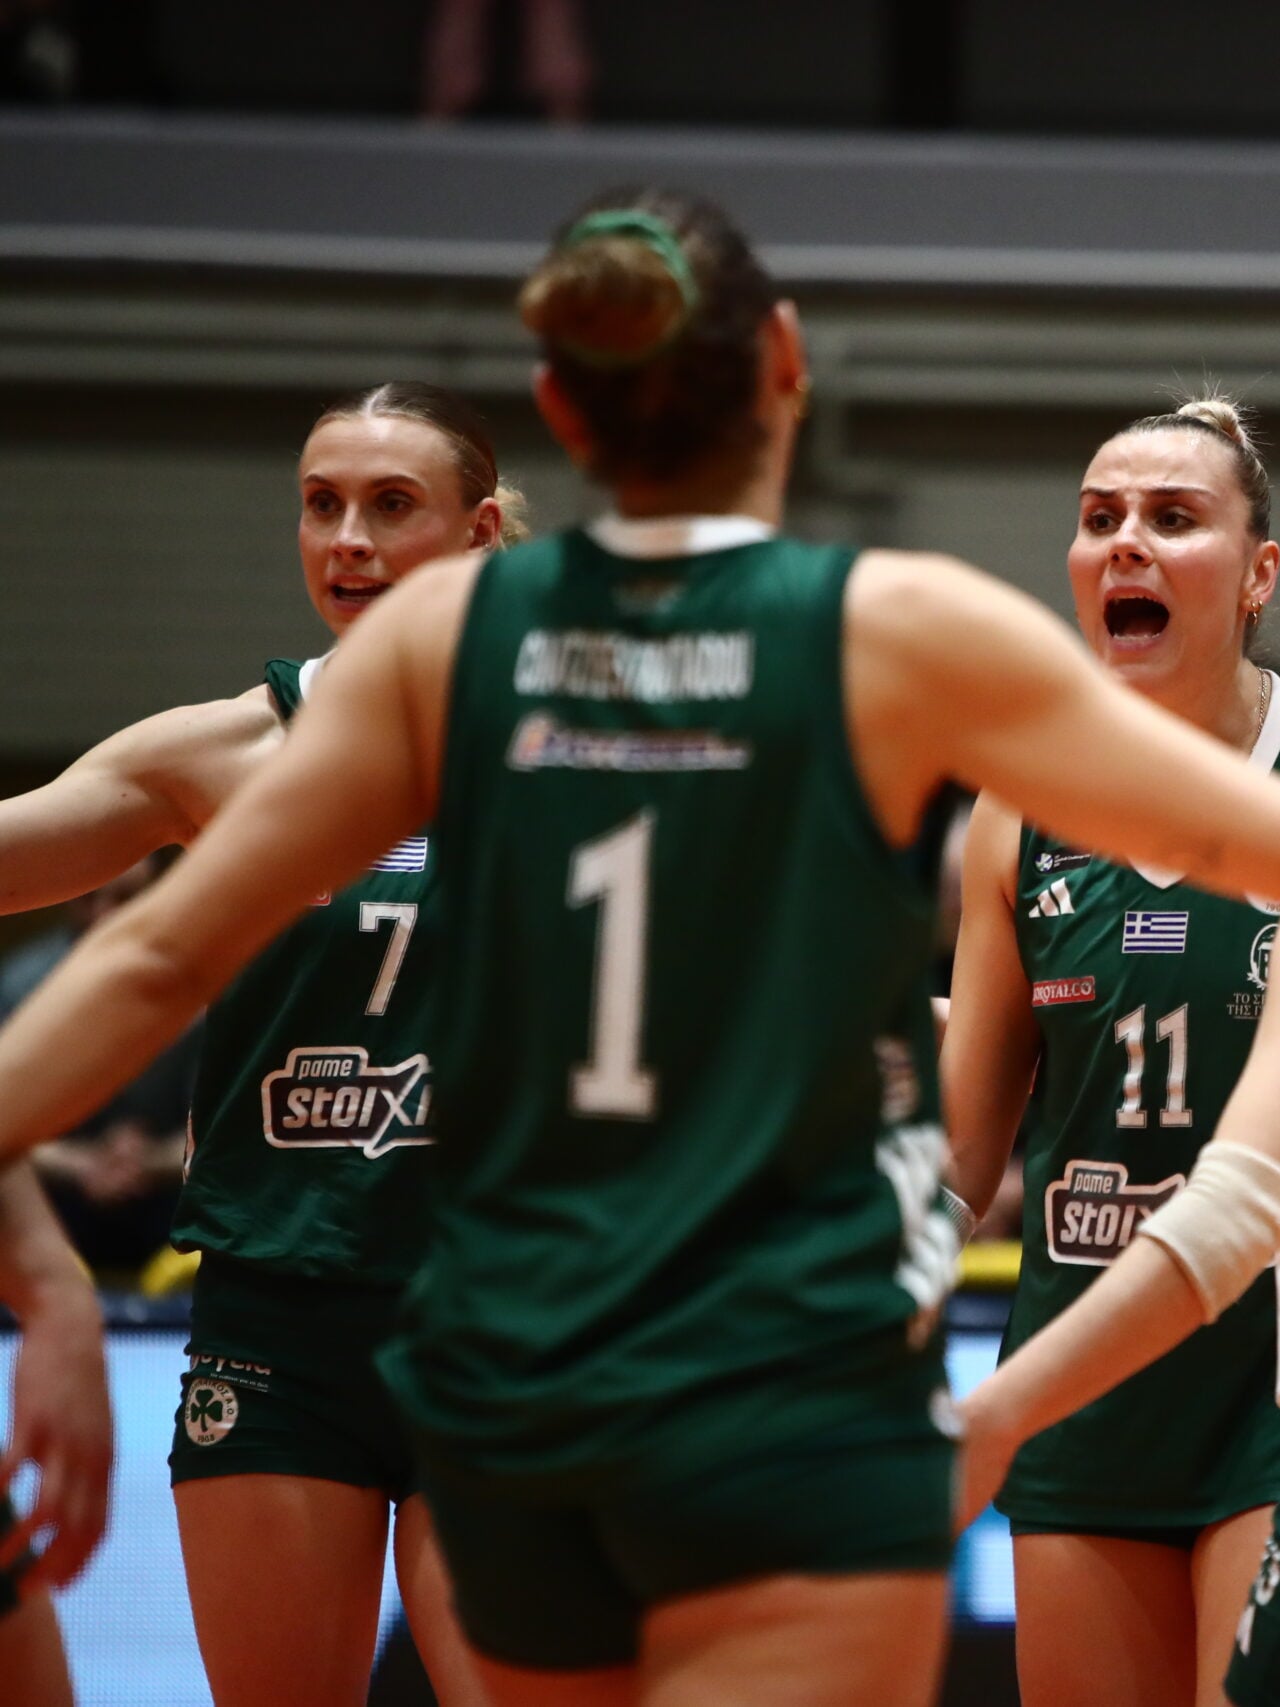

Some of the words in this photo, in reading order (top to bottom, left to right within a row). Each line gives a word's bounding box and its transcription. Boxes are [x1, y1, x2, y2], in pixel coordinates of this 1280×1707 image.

[359, 902, 418, 1016] 7
[566, 808, 656, 1119] 1
[299, 1059, 353, 1080] pame
[1114, 1003, 1193, 1128] 11
[1073, 1172, 1114, 1194] pame
